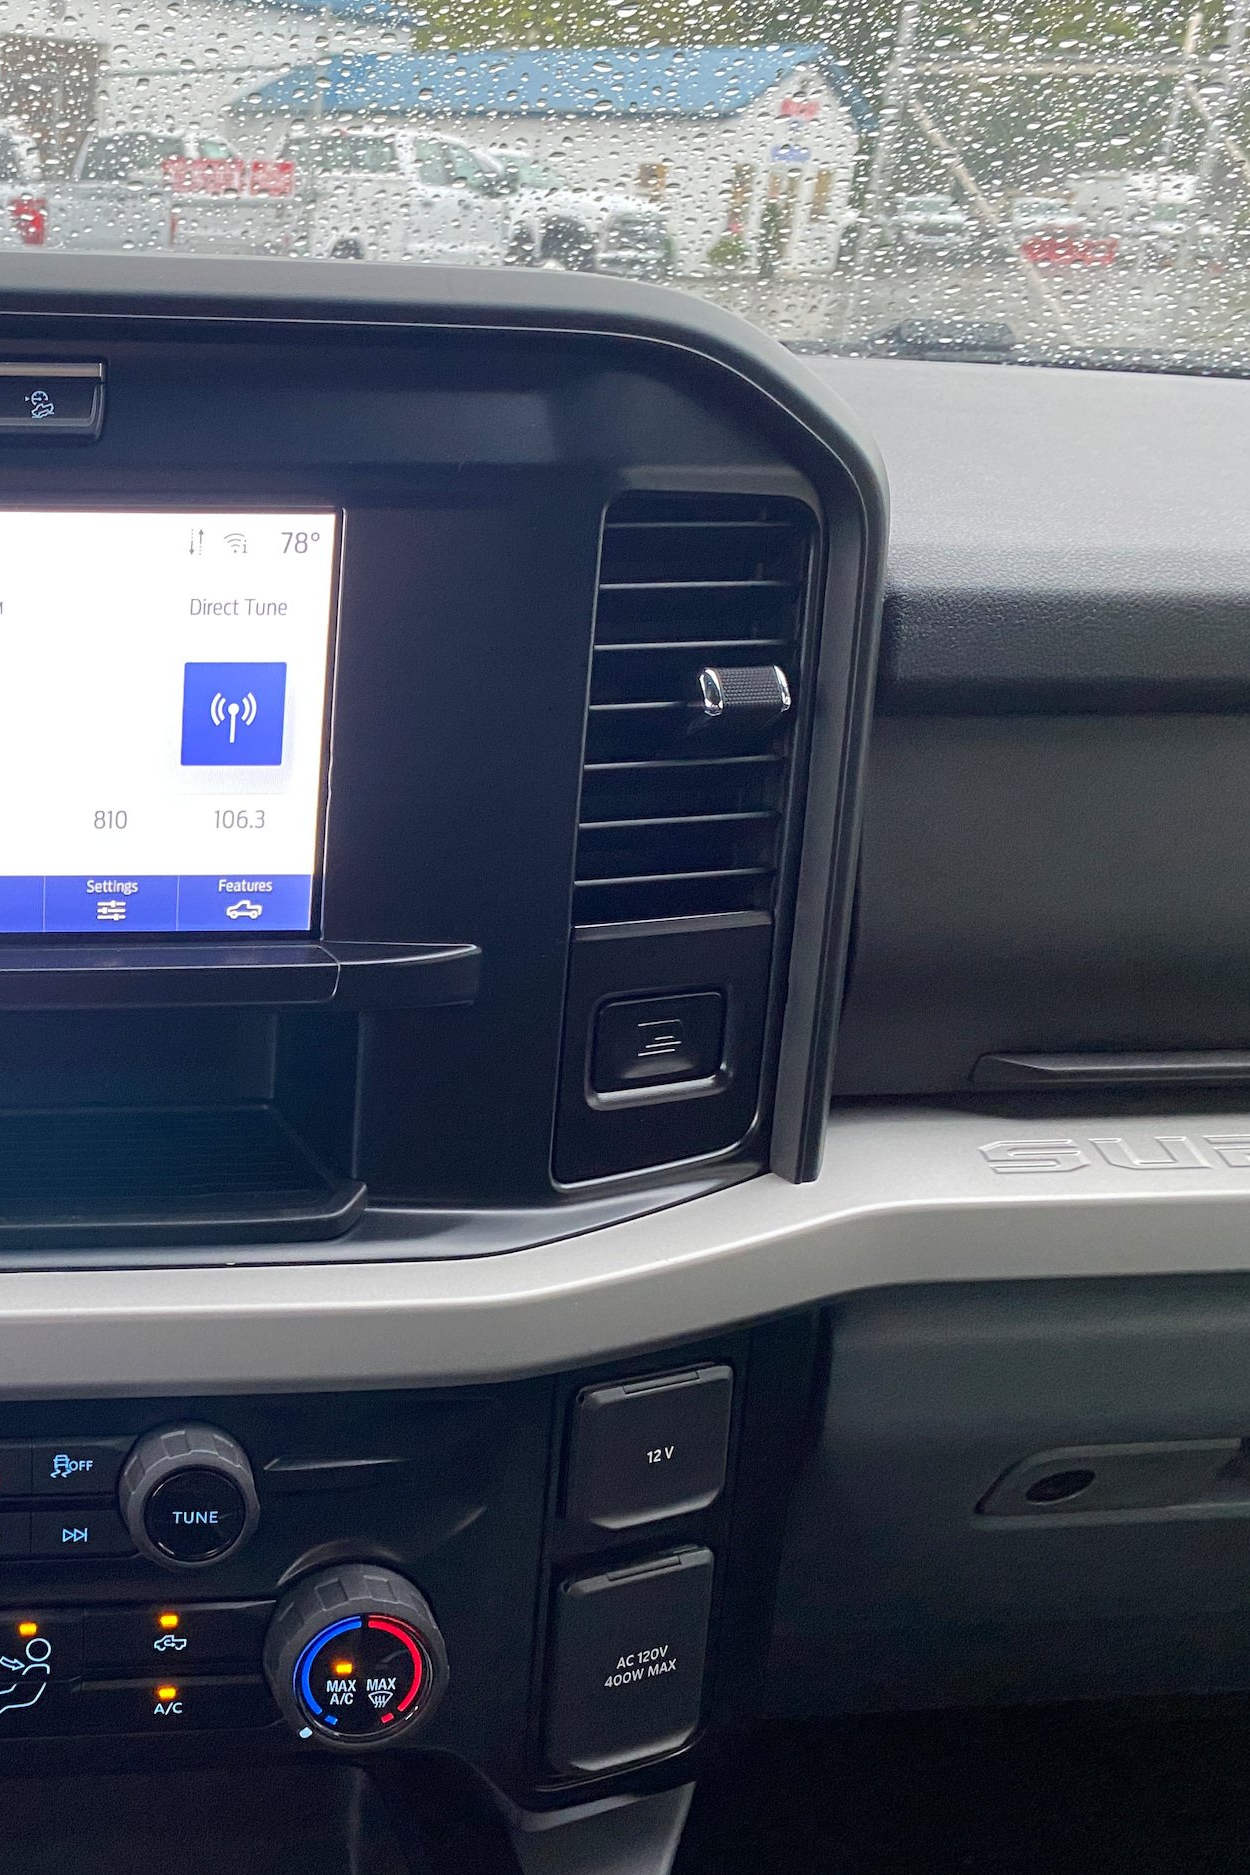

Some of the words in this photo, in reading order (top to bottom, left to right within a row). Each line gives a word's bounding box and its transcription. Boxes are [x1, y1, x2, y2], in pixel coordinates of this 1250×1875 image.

[281, 531, 320, 554] 78°
[190, 598, 239, 616] Direct
[244, 598, 288, 616] Tune
[93, 810, 128, 830] 810
[214, 809, 265, 829] 106.3
[87, 880, 138, 896] Settings
[218, 878, 273, 892] Features
[646, 1448, 662, 1464] 12
[664, 1445, 675, 1460] V
[69, 1459, 94, 1472] OFF
[172, 1510, 219, 1525] TUNE
[616, 1654, 635, 1670] AC
[637, 1645, 669, 1664] 120V
[603, 1668, 645, 1689] 400W
[647, 1658, 677, 1678] MAX
[326, 1679, 357, 1693] MAX
[366, 1677, 397, 1691] MAX
[329, 1692, 354, 1706] A/C
[153, 1701, 183, 1716] A/C
